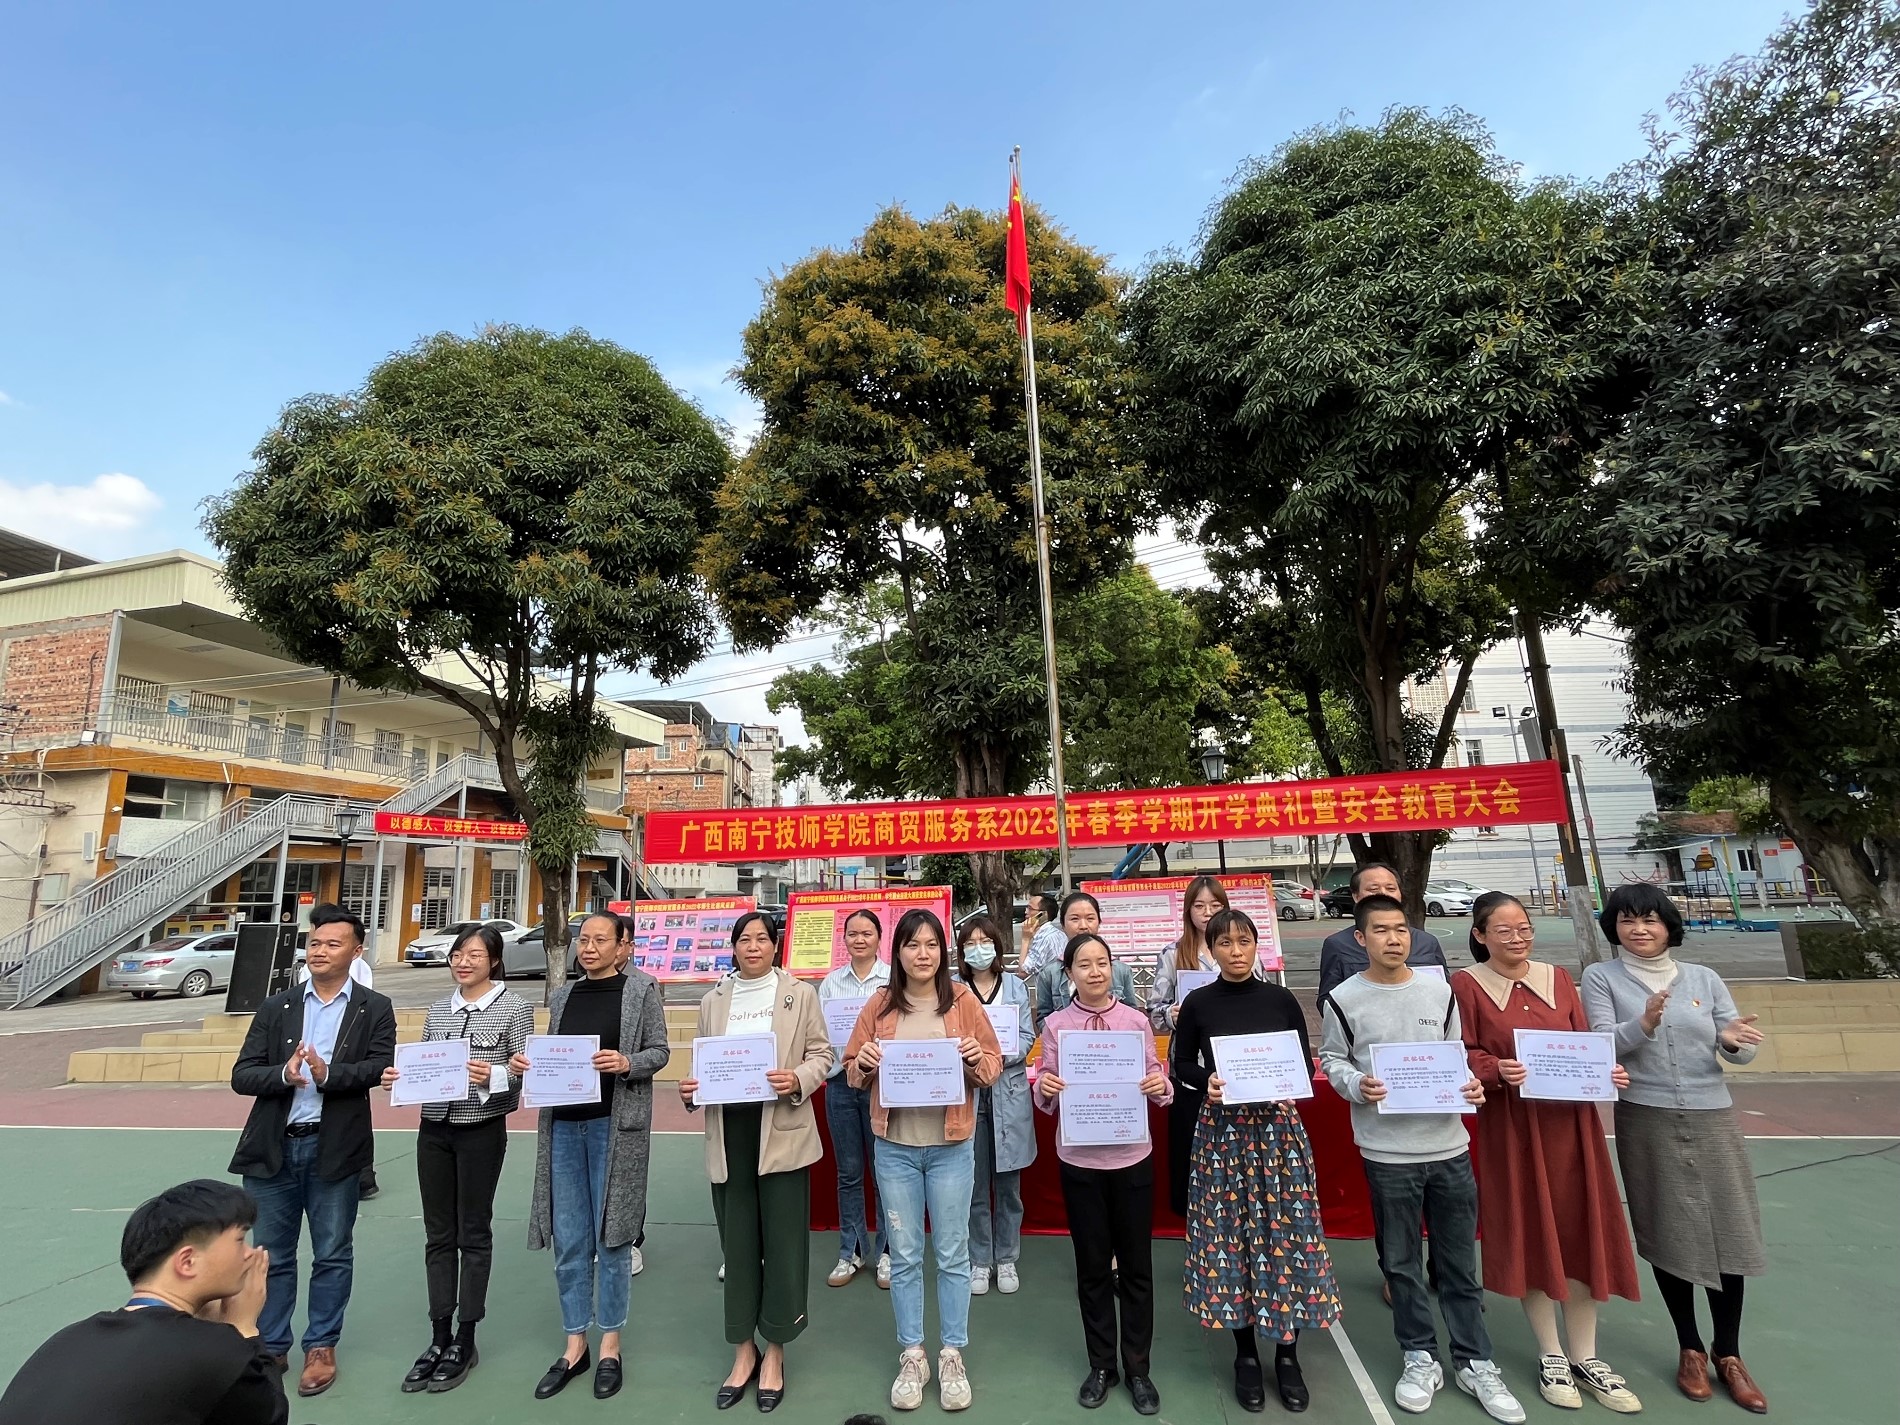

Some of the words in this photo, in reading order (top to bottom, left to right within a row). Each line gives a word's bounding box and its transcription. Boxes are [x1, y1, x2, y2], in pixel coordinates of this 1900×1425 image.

[679, 778, 1521, 855] 广西南宁技师学院商贸服务系2023年春季学期开学典礼暨安全教育大会
